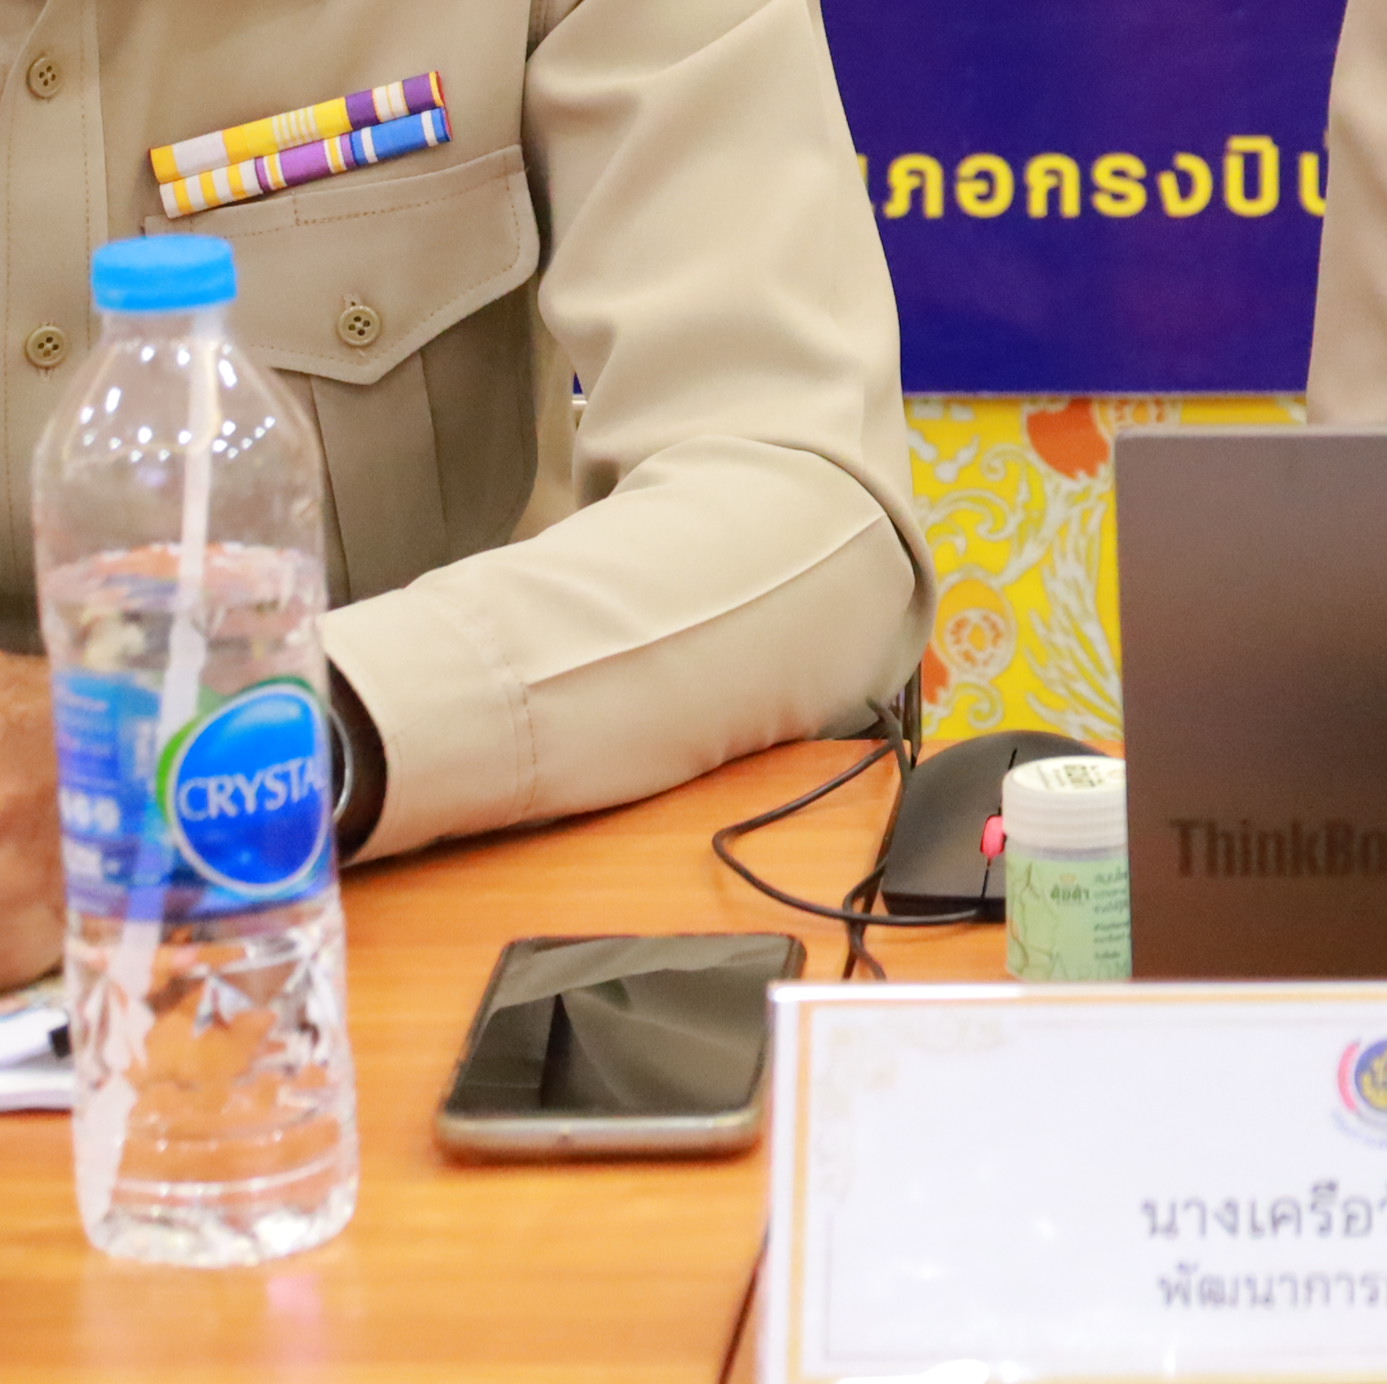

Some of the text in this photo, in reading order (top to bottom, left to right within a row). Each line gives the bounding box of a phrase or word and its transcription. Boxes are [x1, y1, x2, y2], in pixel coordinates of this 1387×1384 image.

[857, 134, 1327, 218] ภอกรงปิ
[178, 754, 328, 821] CRYSTA
